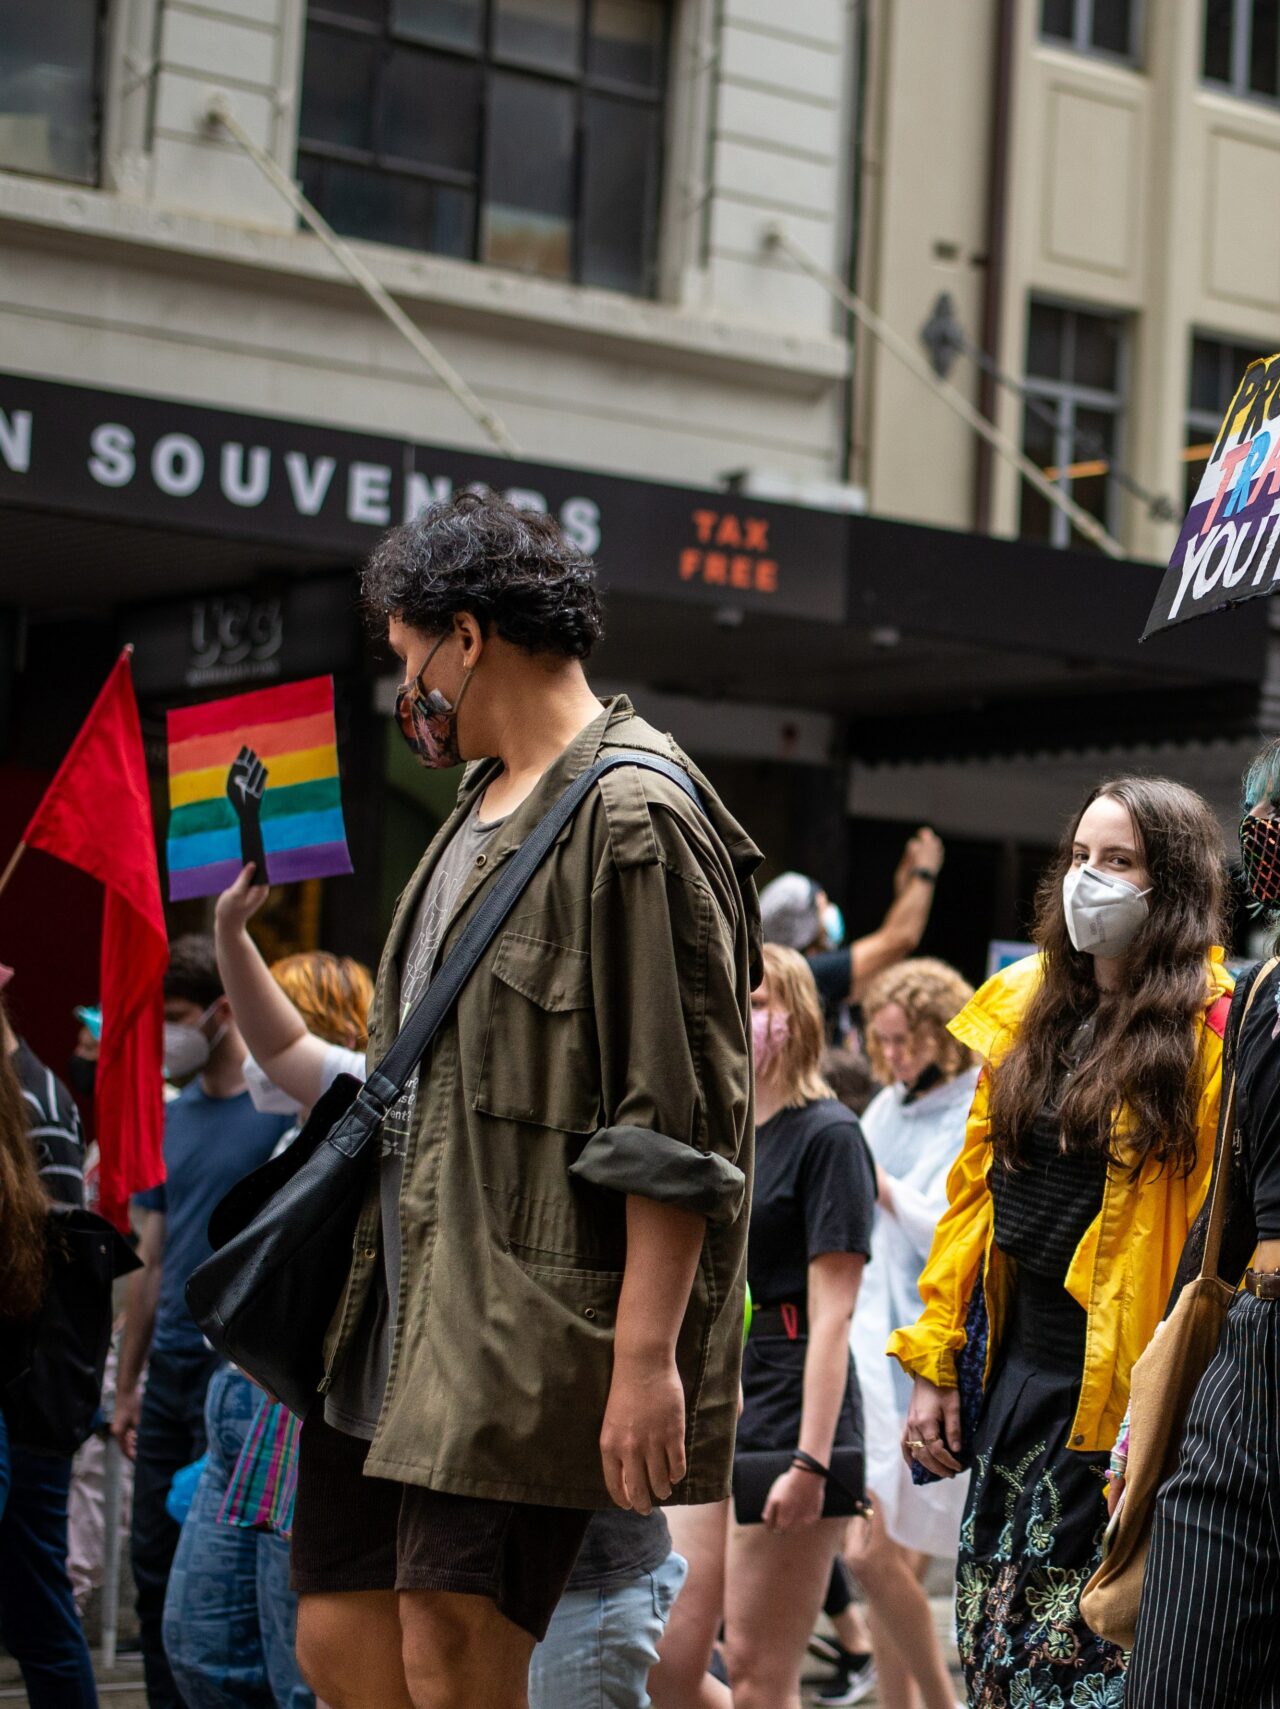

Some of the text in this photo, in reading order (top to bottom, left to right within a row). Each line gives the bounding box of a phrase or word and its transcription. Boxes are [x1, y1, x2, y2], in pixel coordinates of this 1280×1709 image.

[88, 422, 600, 556] SOUVENS
[691, 508, 769, 552] TAX
[679, 546, 778, 592] FREE
